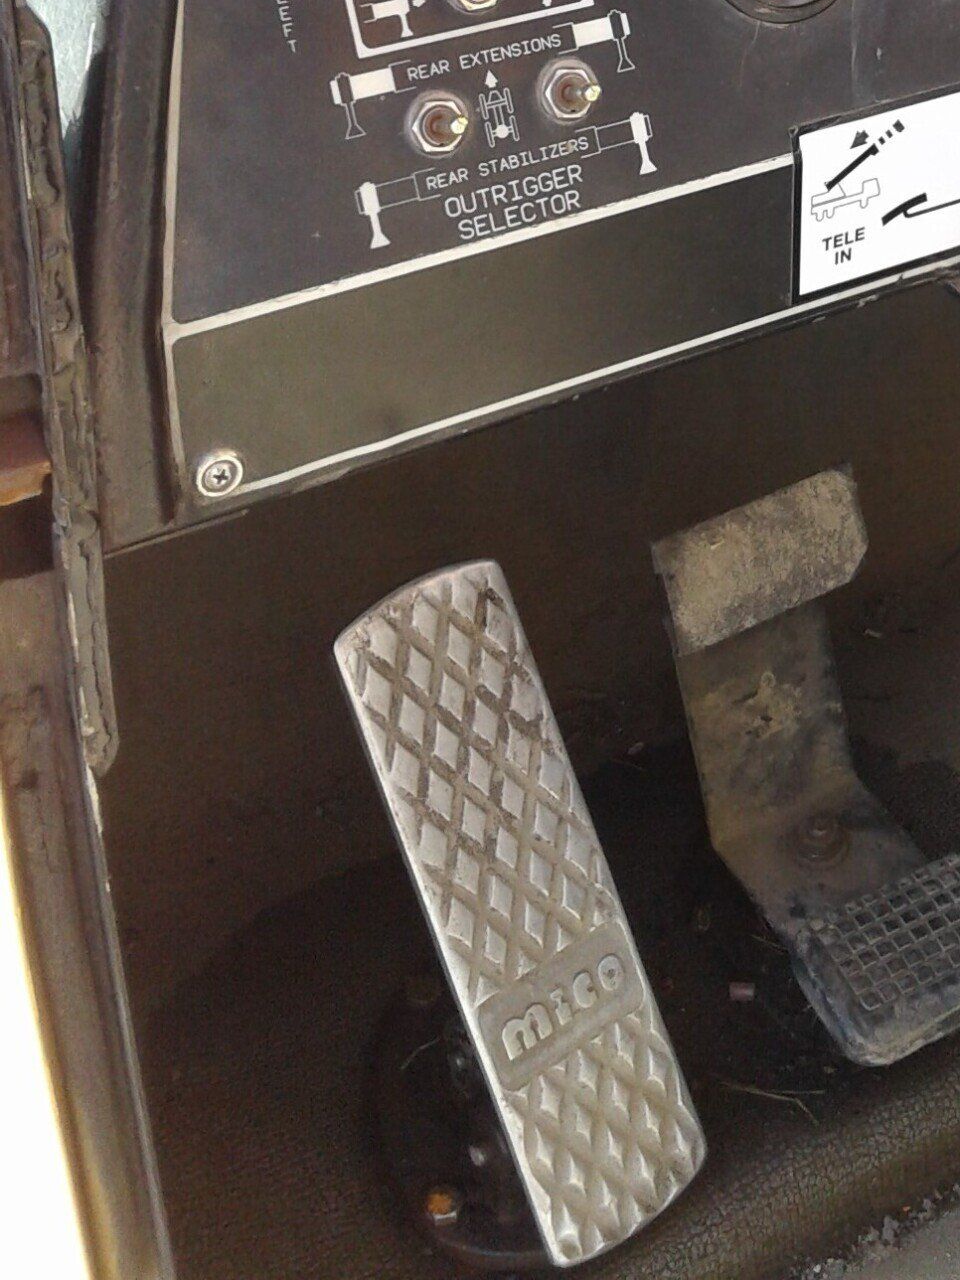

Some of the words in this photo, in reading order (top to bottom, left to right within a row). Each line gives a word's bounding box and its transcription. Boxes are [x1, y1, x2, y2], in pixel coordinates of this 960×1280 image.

[406, 59, 451, 81] REAR
[459, 34, 562, 70] EXTENSIONS
[426, 168, 469, 190] REAR
[478, 136, 589, 176] STABILIZERS
[444, 164, 584, 218] OUTRIGGER
[458, 190, 582, 240] SELECTOR
[822, 227, 866, 251] TELE
[834, 247, 852, 265] IN
[502, 954, 623, 1061] mico
